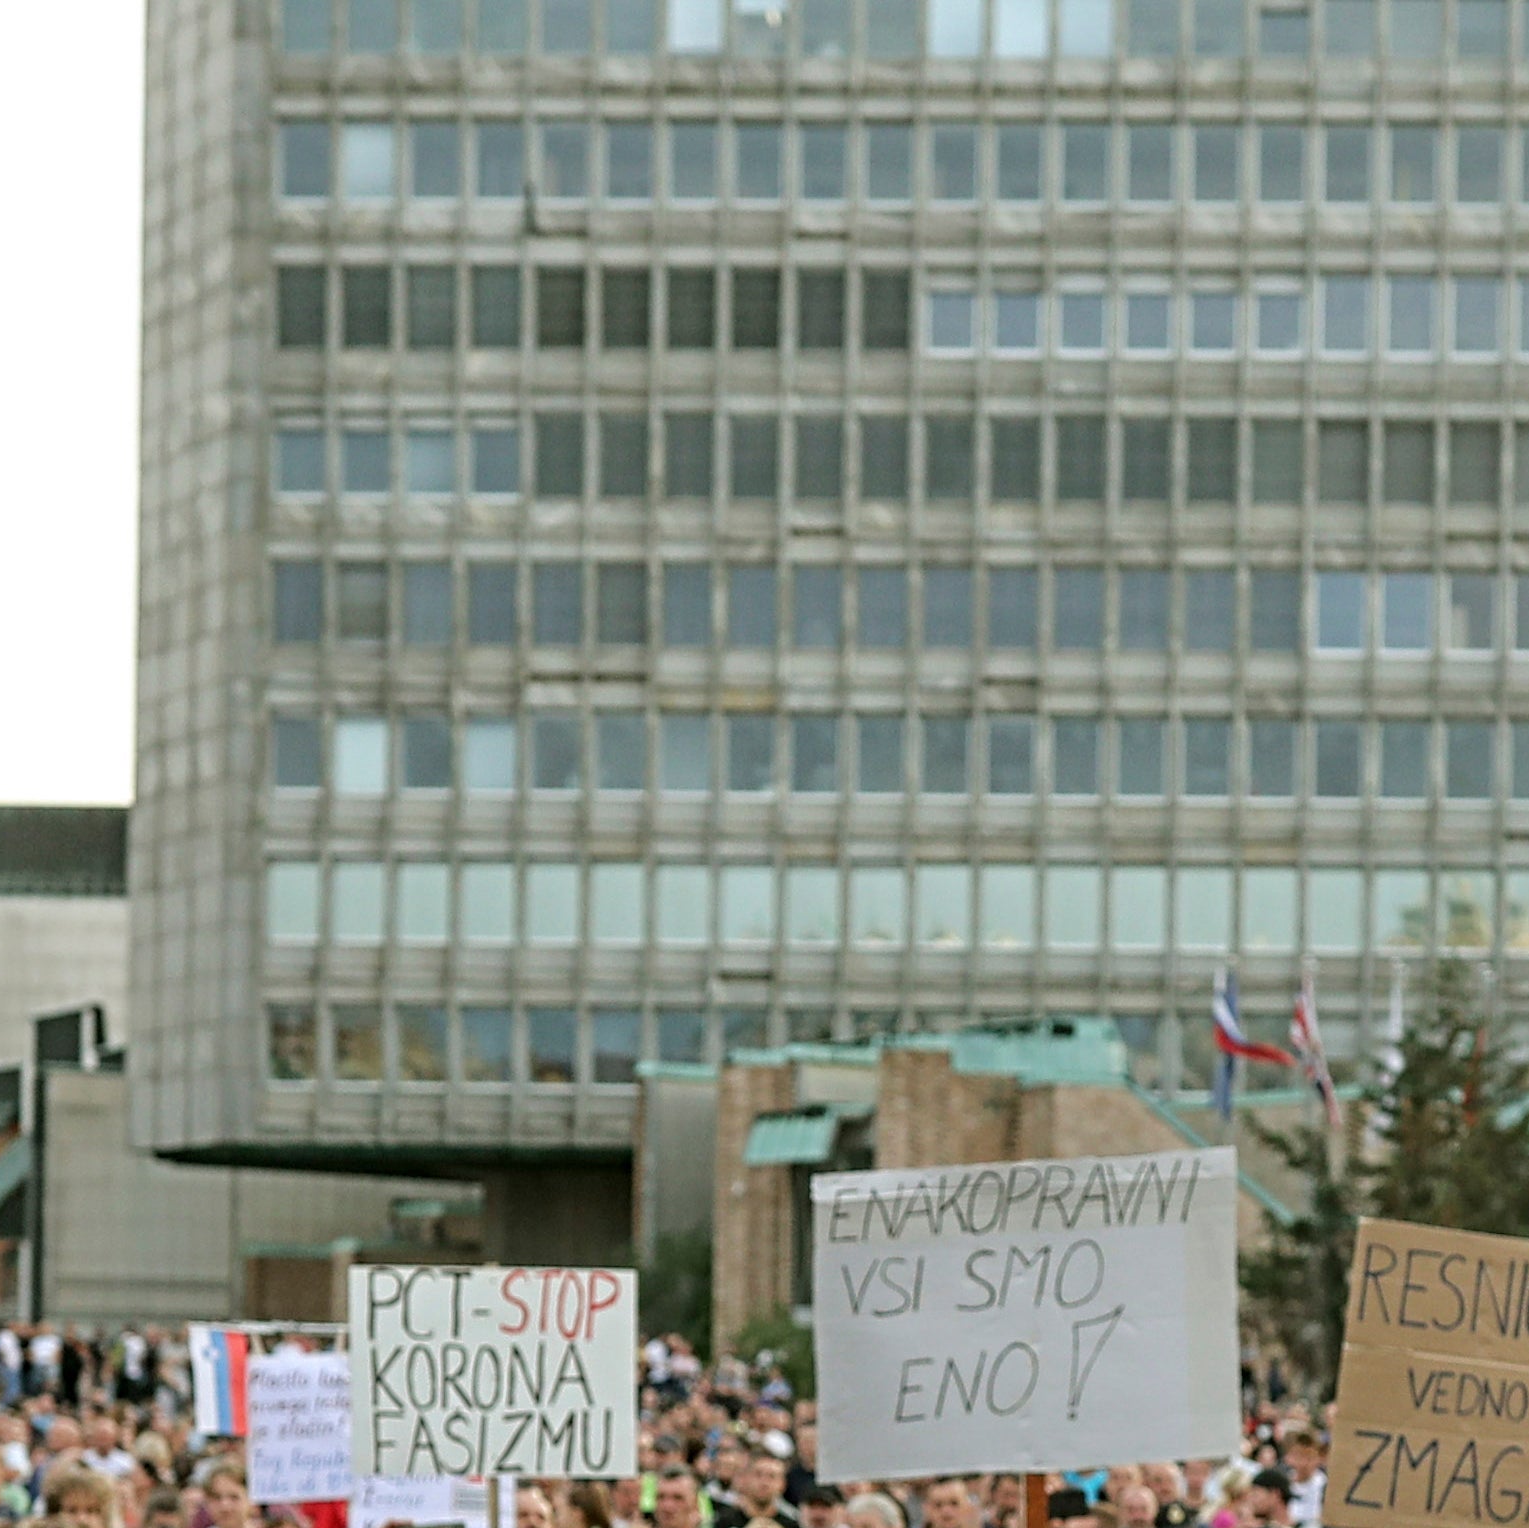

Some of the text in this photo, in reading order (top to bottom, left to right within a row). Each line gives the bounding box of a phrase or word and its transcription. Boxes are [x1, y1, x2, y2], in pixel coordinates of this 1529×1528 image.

[826, 1157, 1203, 1246] ENAKOPRAVNI
[840, 1237, 1108, 1319] VSI SMO
[369, 1336, 592, 1413] KORONA
